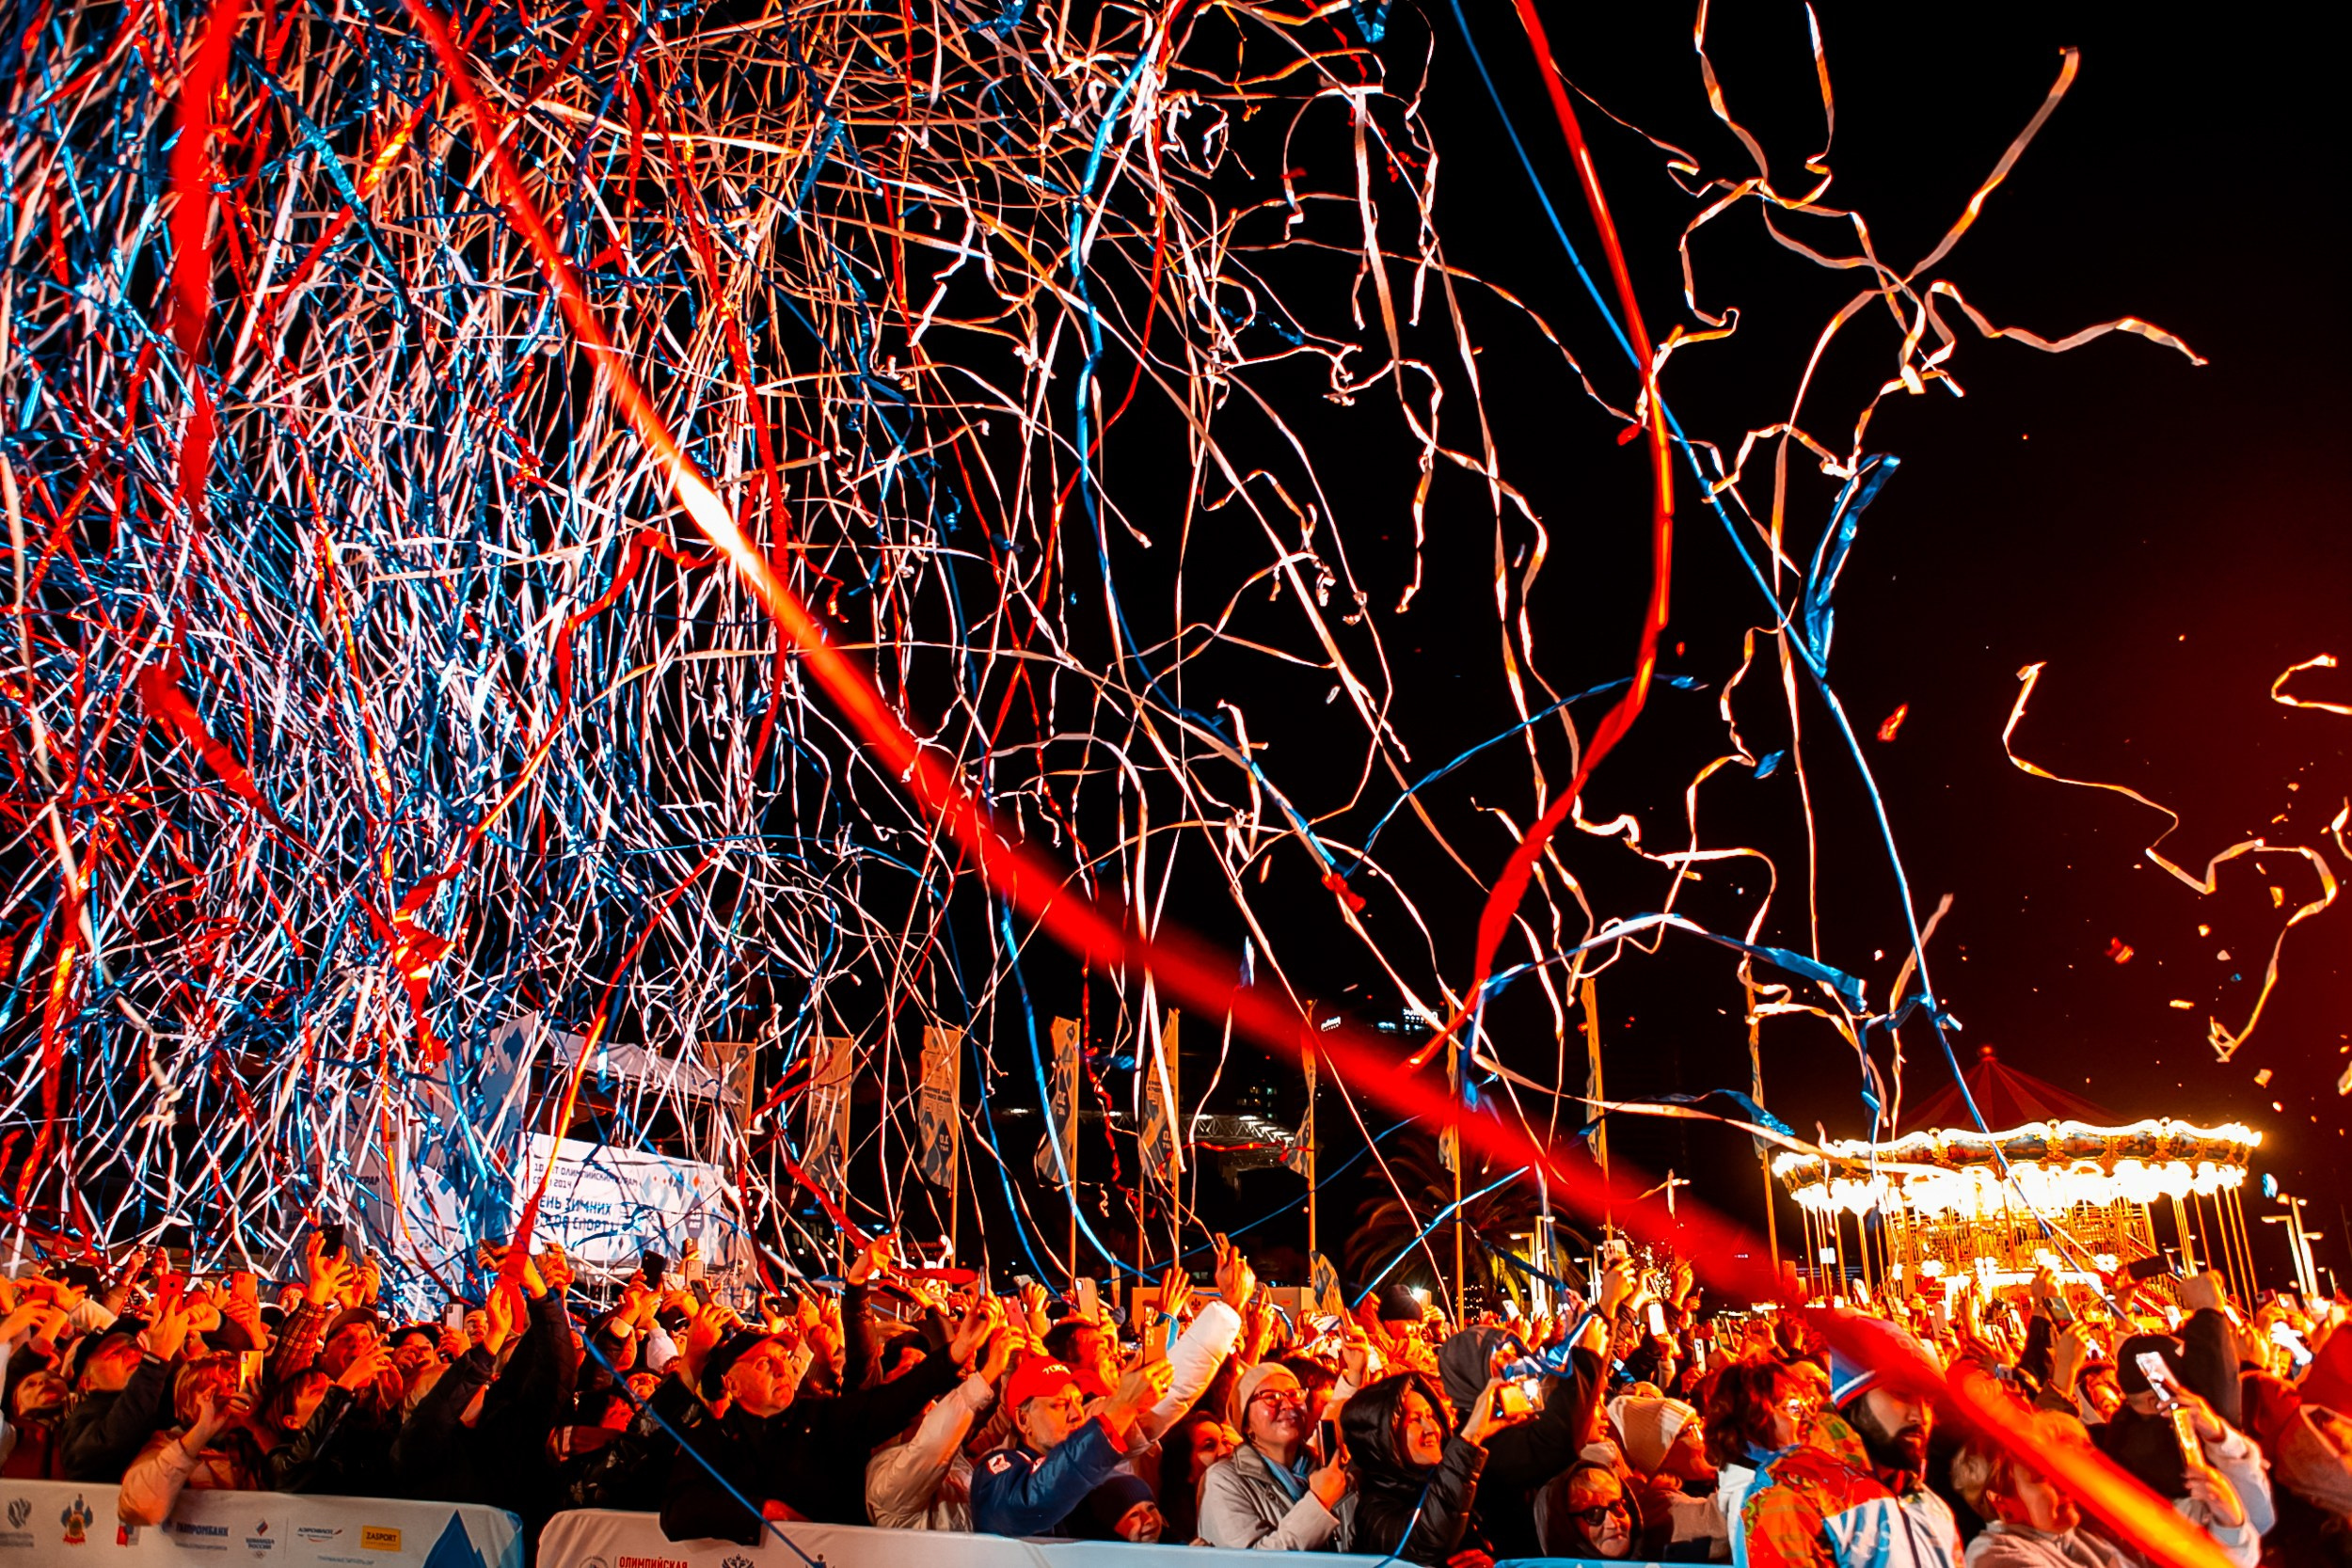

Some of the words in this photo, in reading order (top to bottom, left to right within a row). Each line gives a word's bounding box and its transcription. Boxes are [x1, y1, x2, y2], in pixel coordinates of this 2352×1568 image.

[534, 1163, 544, 1173] 10
[553, 1178, 573, 1189] 2014
[366, 1531, 397, 1543] ZASPORT
[619, 1556, 688, 1568] ОЛИМПИЙСКАЯ
